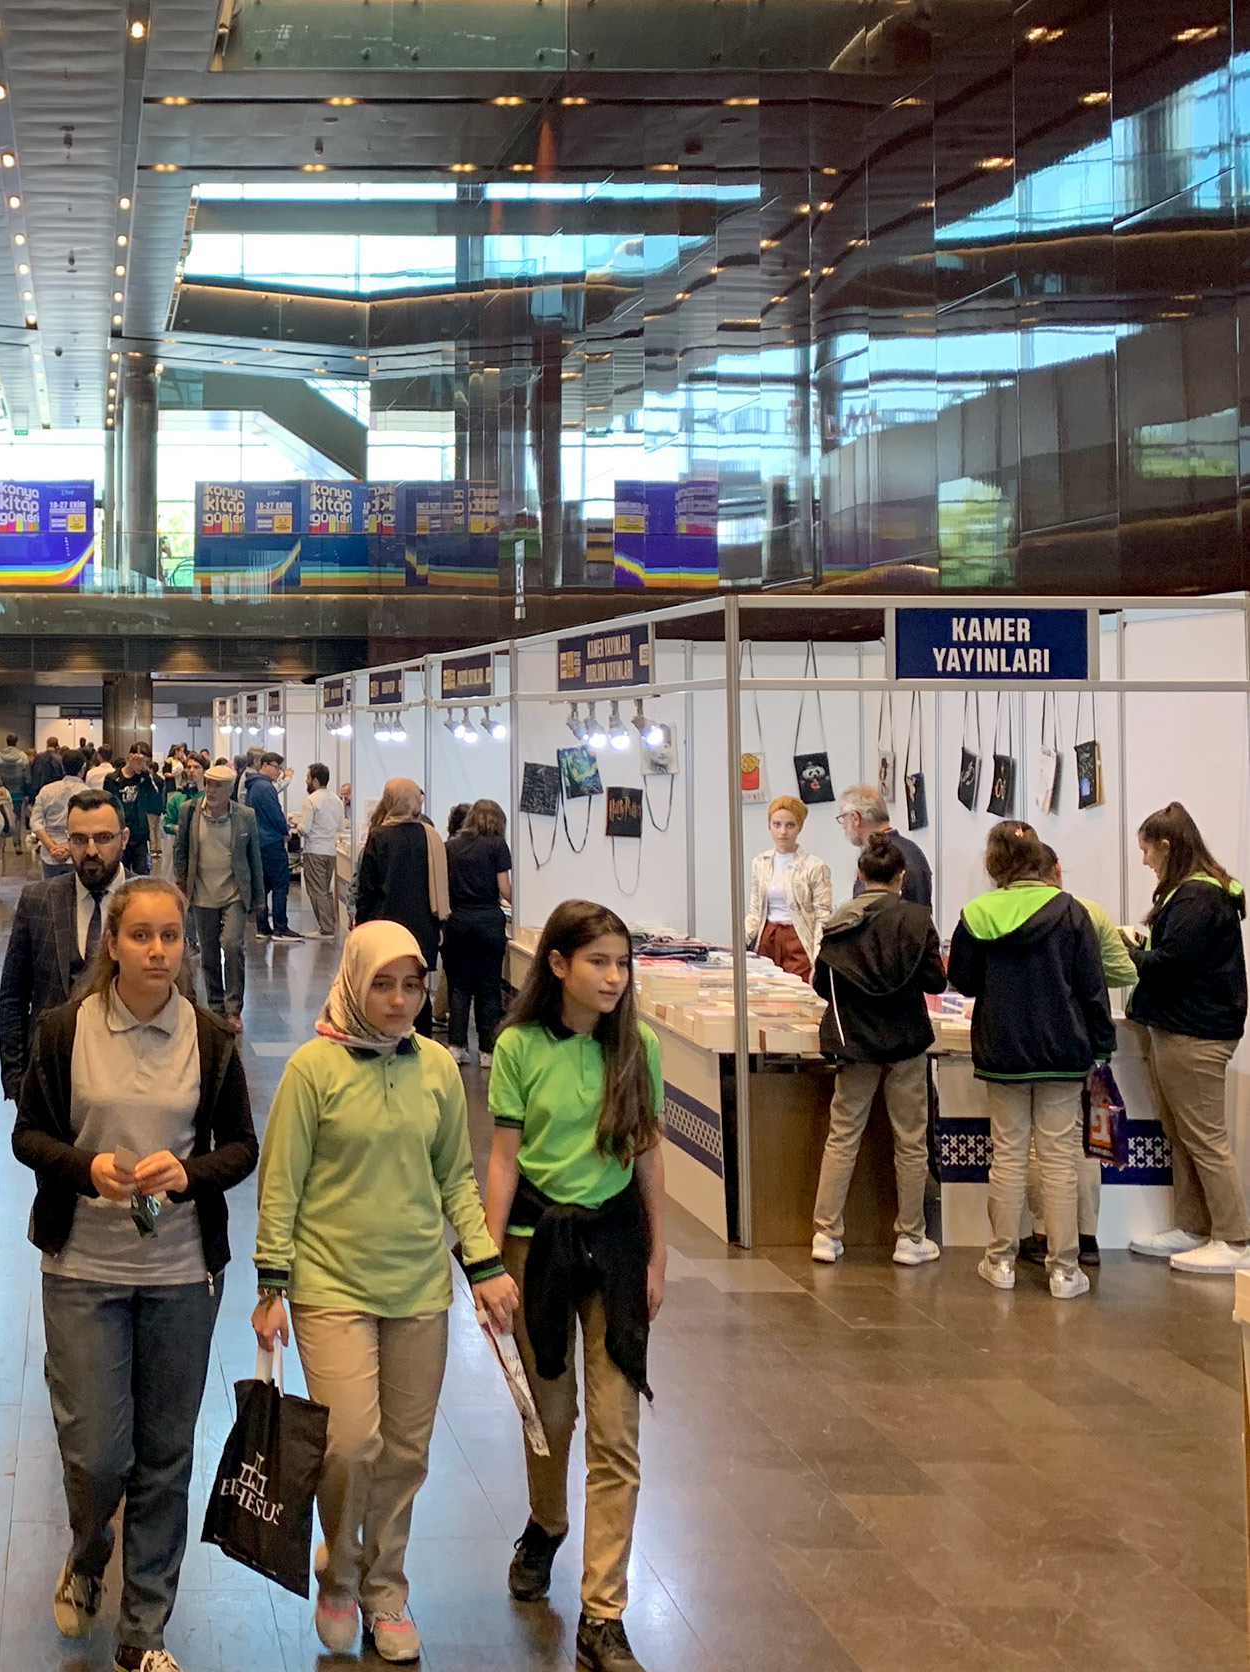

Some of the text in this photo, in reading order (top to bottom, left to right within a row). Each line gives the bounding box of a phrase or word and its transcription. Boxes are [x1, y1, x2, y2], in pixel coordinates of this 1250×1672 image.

[203, 482, 245, 500] konya
[310, 482, 352, 500] konya
[203, 495, 245, 514] kitap
[310, 495, 352, 514] kitap
[202, 512, 245, 527] günleri
[310, 512, 352, 527] günleri
[952, 617, 1031, 642] KAMER
[932, 648, 1050, 673] YAYINLARI
